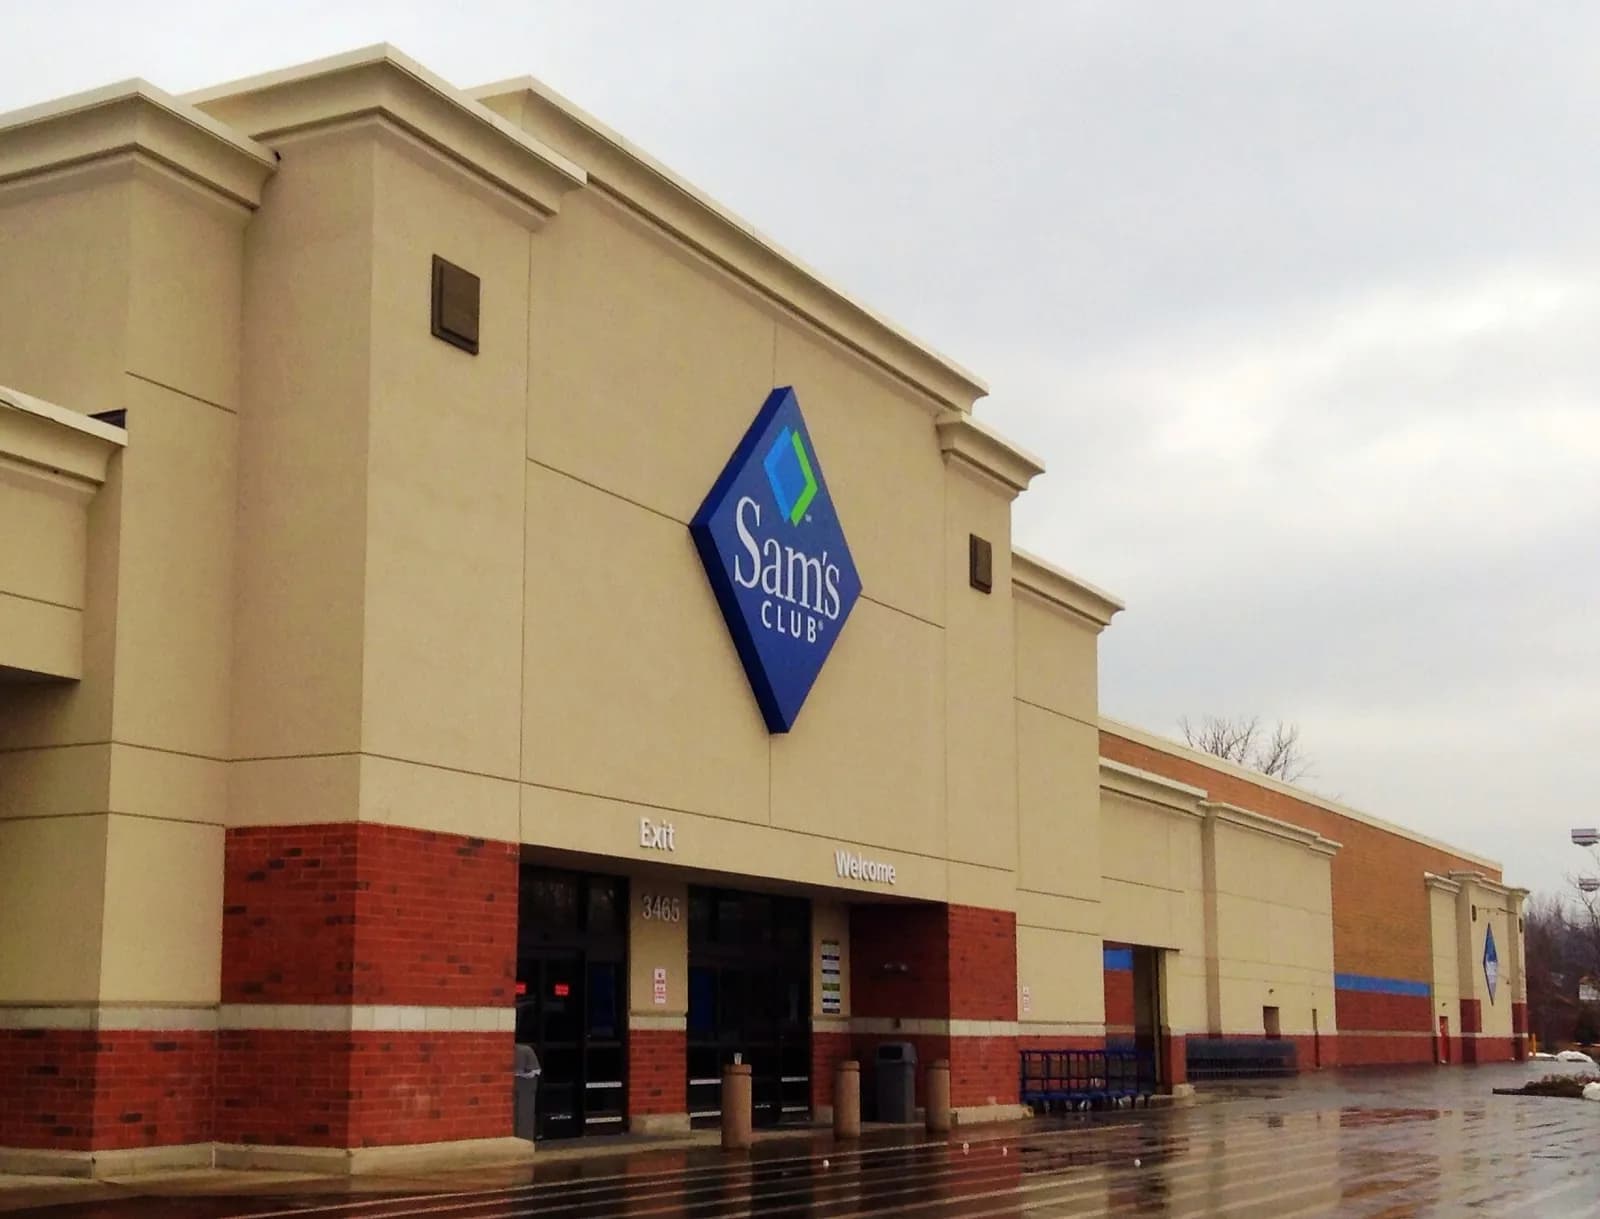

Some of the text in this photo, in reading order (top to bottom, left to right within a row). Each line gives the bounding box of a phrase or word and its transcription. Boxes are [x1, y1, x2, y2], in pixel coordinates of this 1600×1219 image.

[735, 496, 840, 620] Sam's
[761, 600, 817, 644] CLUB
[640, 817, 675, 851] Exit
[834, 849, 897, 885] Welcome
[642, 895, 680, 922] 3465
